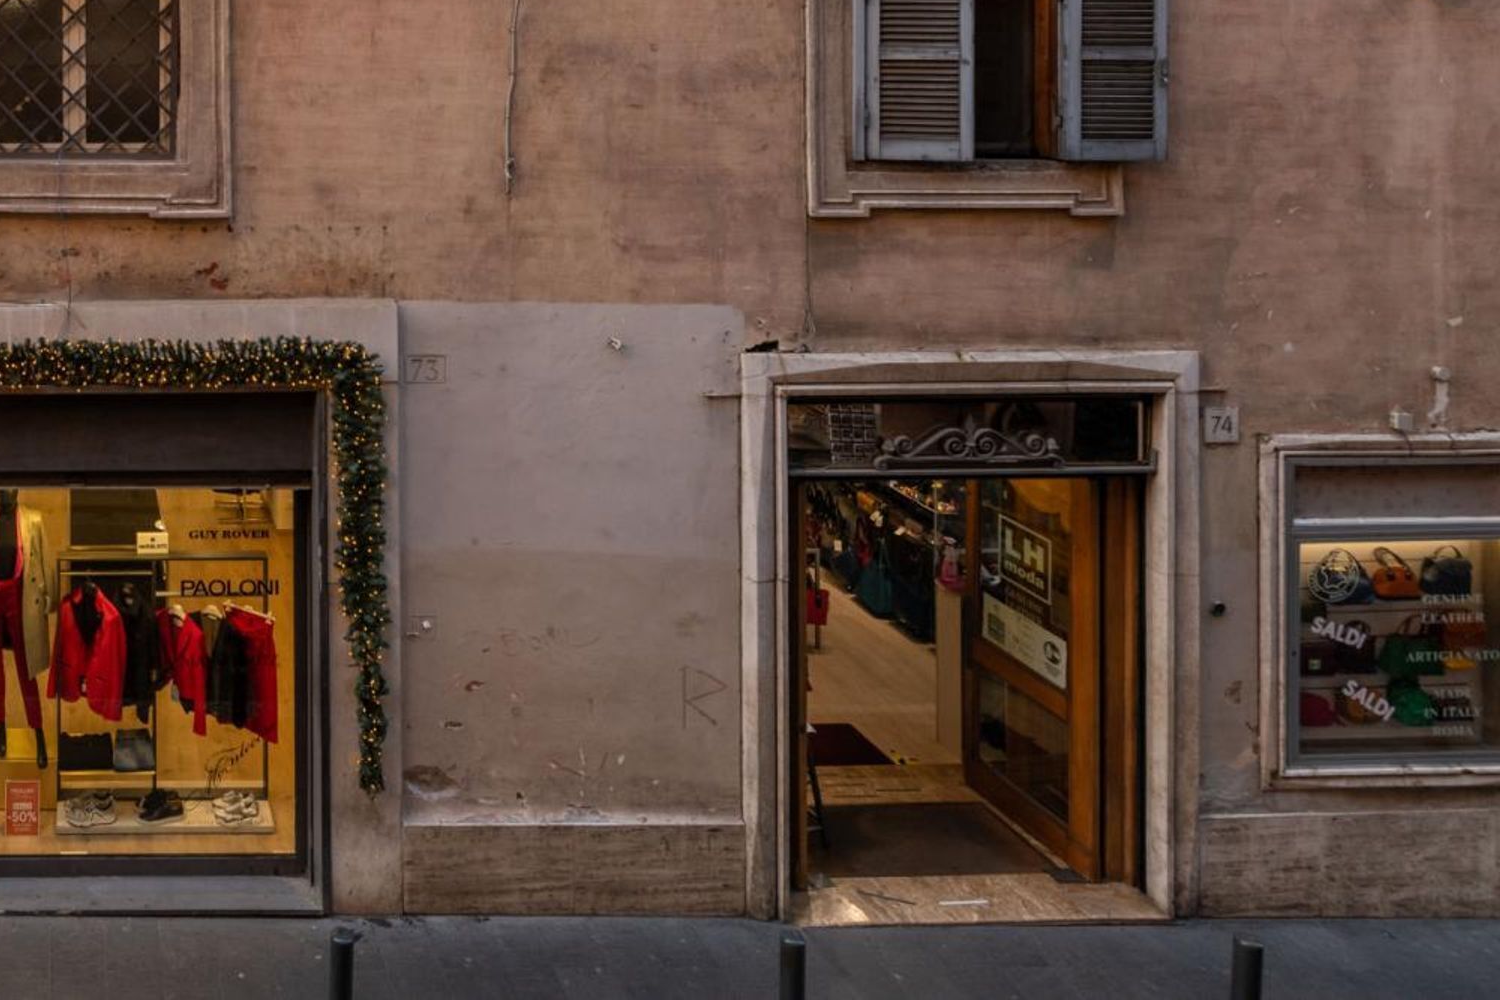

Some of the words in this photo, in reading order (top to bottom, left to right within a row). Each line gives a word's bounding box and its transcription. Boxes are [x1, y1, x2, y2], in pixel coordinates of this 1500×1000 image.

[410, 358, 439, 381] 73
[1211, 415, 1233, 434] 74
[188, 529, 218, 540] GUY
[221, 529, 271, 540] ROVER
[1004, 526, 1045, 573] LH
[1003, 560, 1045, 591] moda
[180, 579, 280, 597] PAOLONI
[1421, 593, 1483, 606] GENUINE
[1420, 612, 1485, 624] LEATHER
[1310, 615, 1367, 650] SALDI
[1405, 650, 1500, 663] ARTIGIANATO
[1341, 679, 1396, 722] SALDI
[1433, 688, 1472, 699] MADE
[1423, 707, 1439, 719] IN
[1442, 706, 1483, 718] ITALY
[1432, 725, 1474, 737] ROMA
